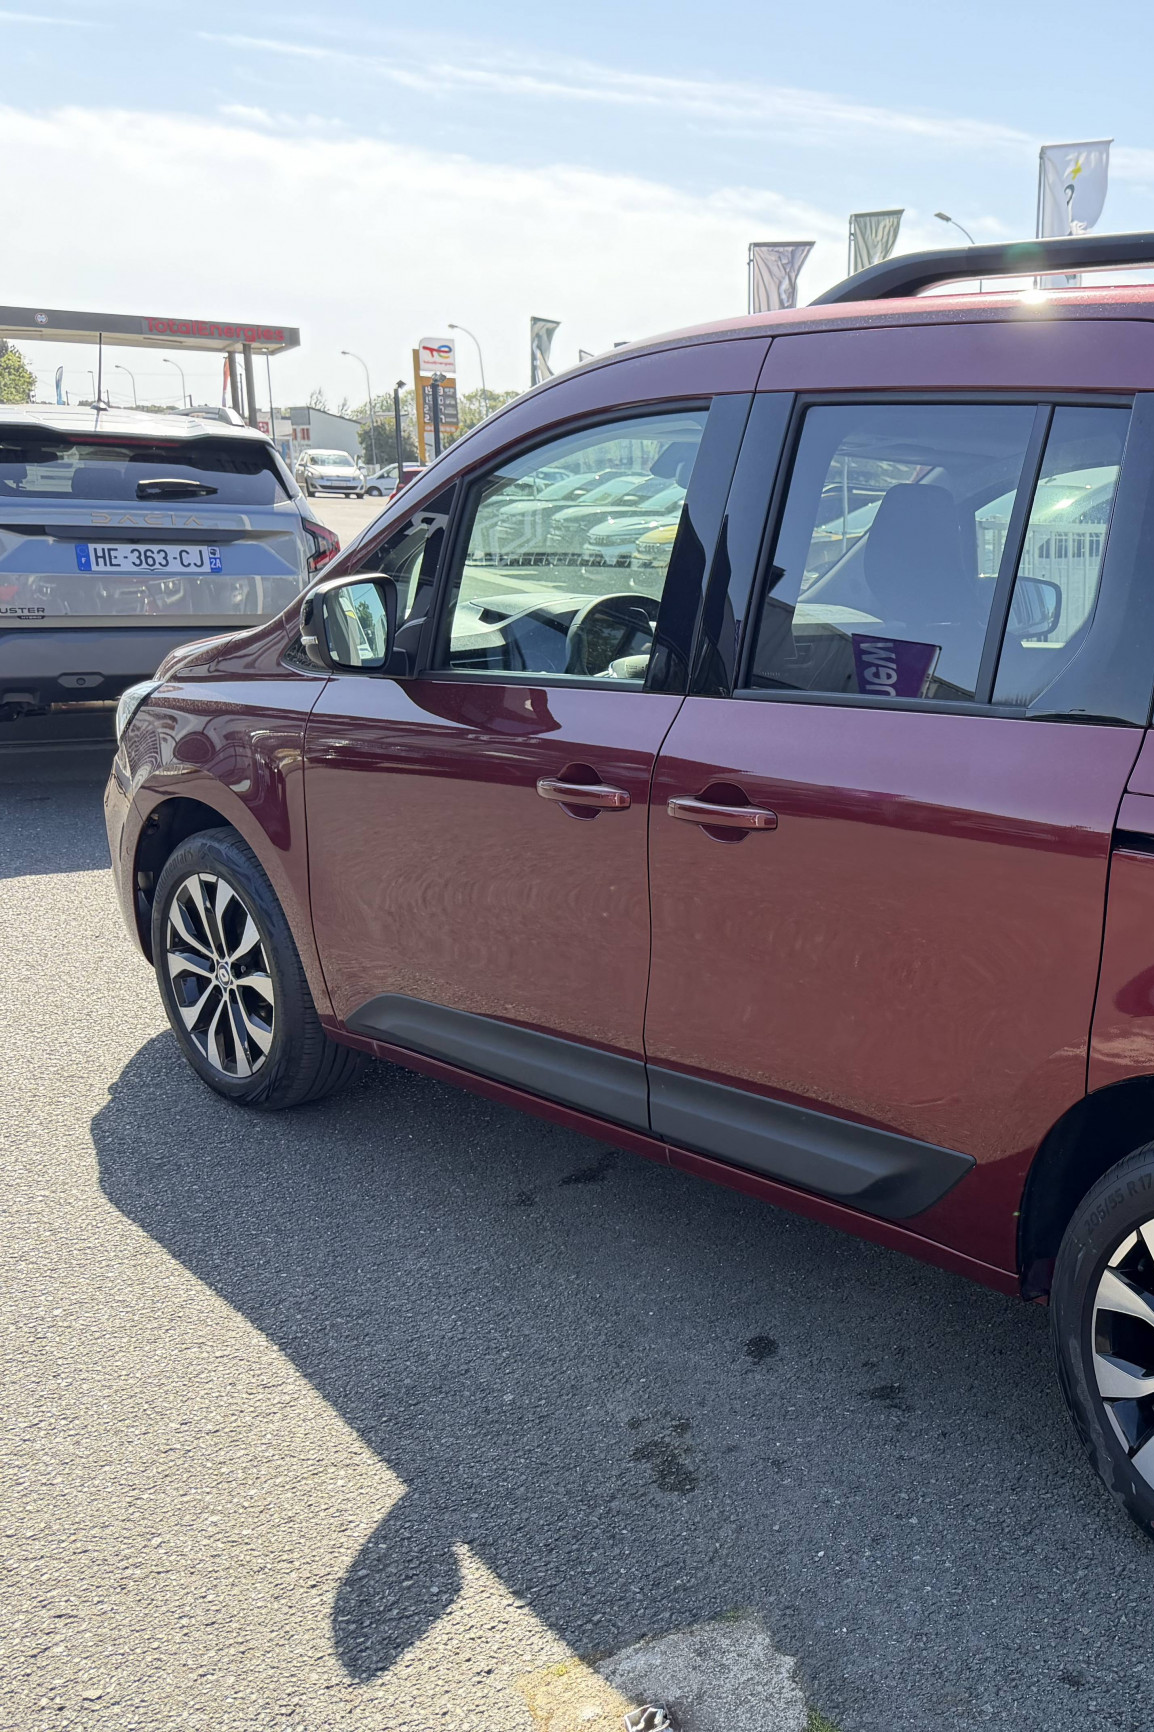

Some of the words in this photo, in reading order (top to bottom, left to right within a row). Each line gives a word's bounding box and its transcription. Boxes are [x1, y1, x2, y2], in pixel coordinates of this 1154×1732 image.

[144, 316, 285, 342] TotalEnergies
[91, 512, 203, 526] DACIA
[93, 547, 204, 568] HE-363-CJ
